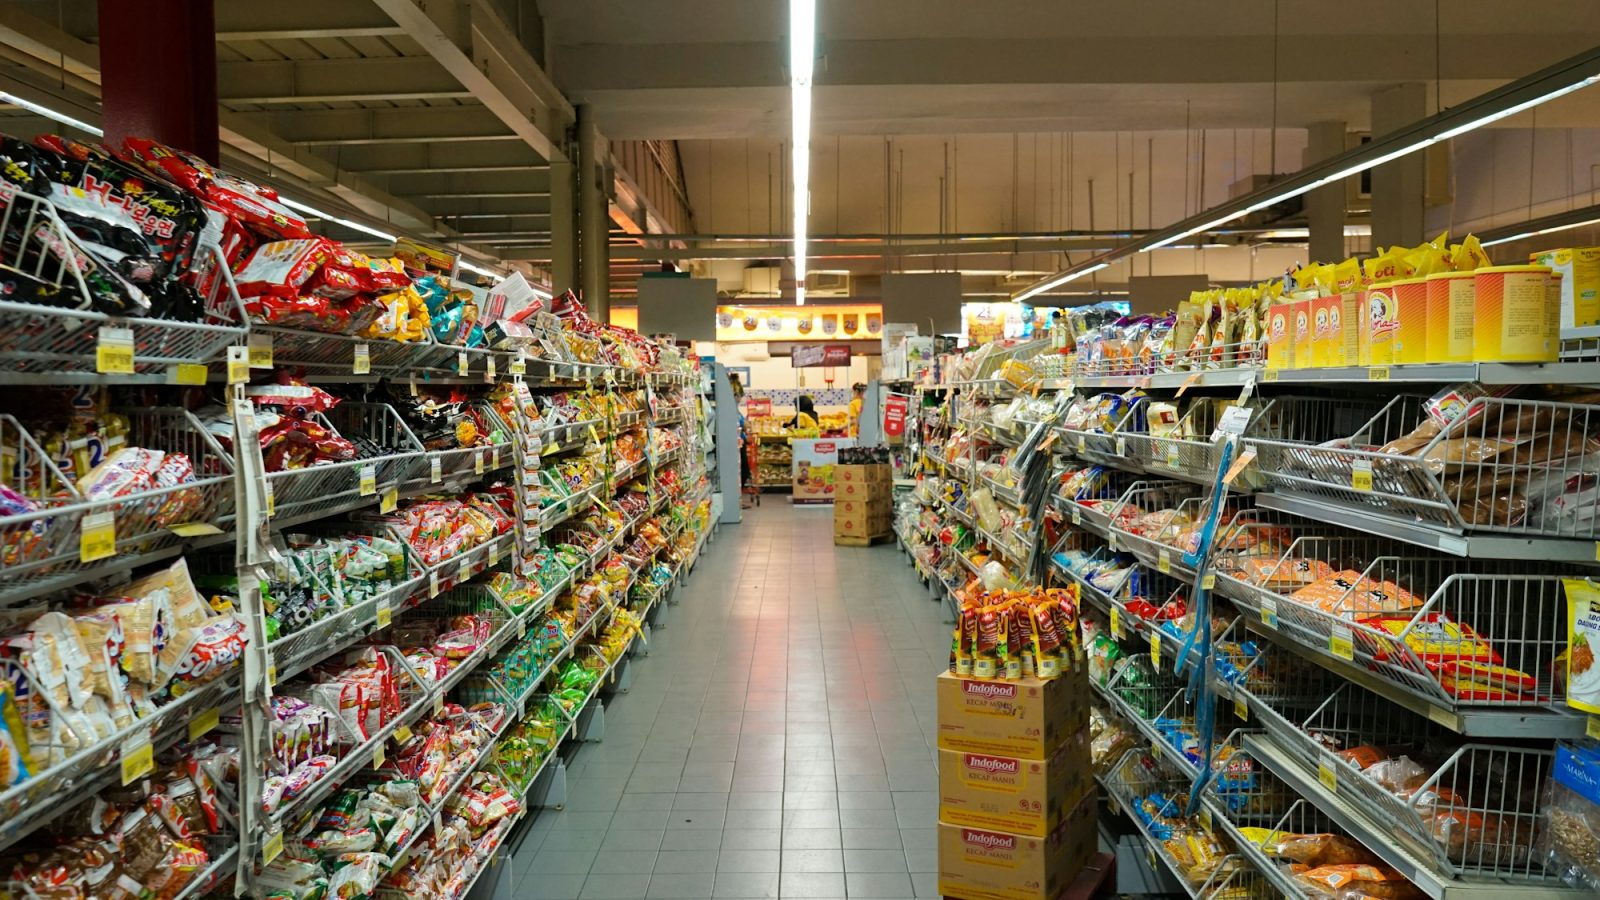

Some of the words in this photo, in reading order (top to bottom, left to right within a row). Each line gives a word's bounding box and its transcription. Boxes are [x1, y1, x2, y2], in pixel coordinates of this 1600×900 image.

[968, 682, 1013, 697] Indofood
[966, 698, 988, 707] KECAP
[970, 756, 1015, 772] Indofood
[968, 772, 990, 782] KECAP
[991, 775, 1016, 785] MANIS
[967, 831, 1013, 847] Indofood
[966, 848, 988, 857] KECAP
[989, 851, 1013, 861] MANIS
